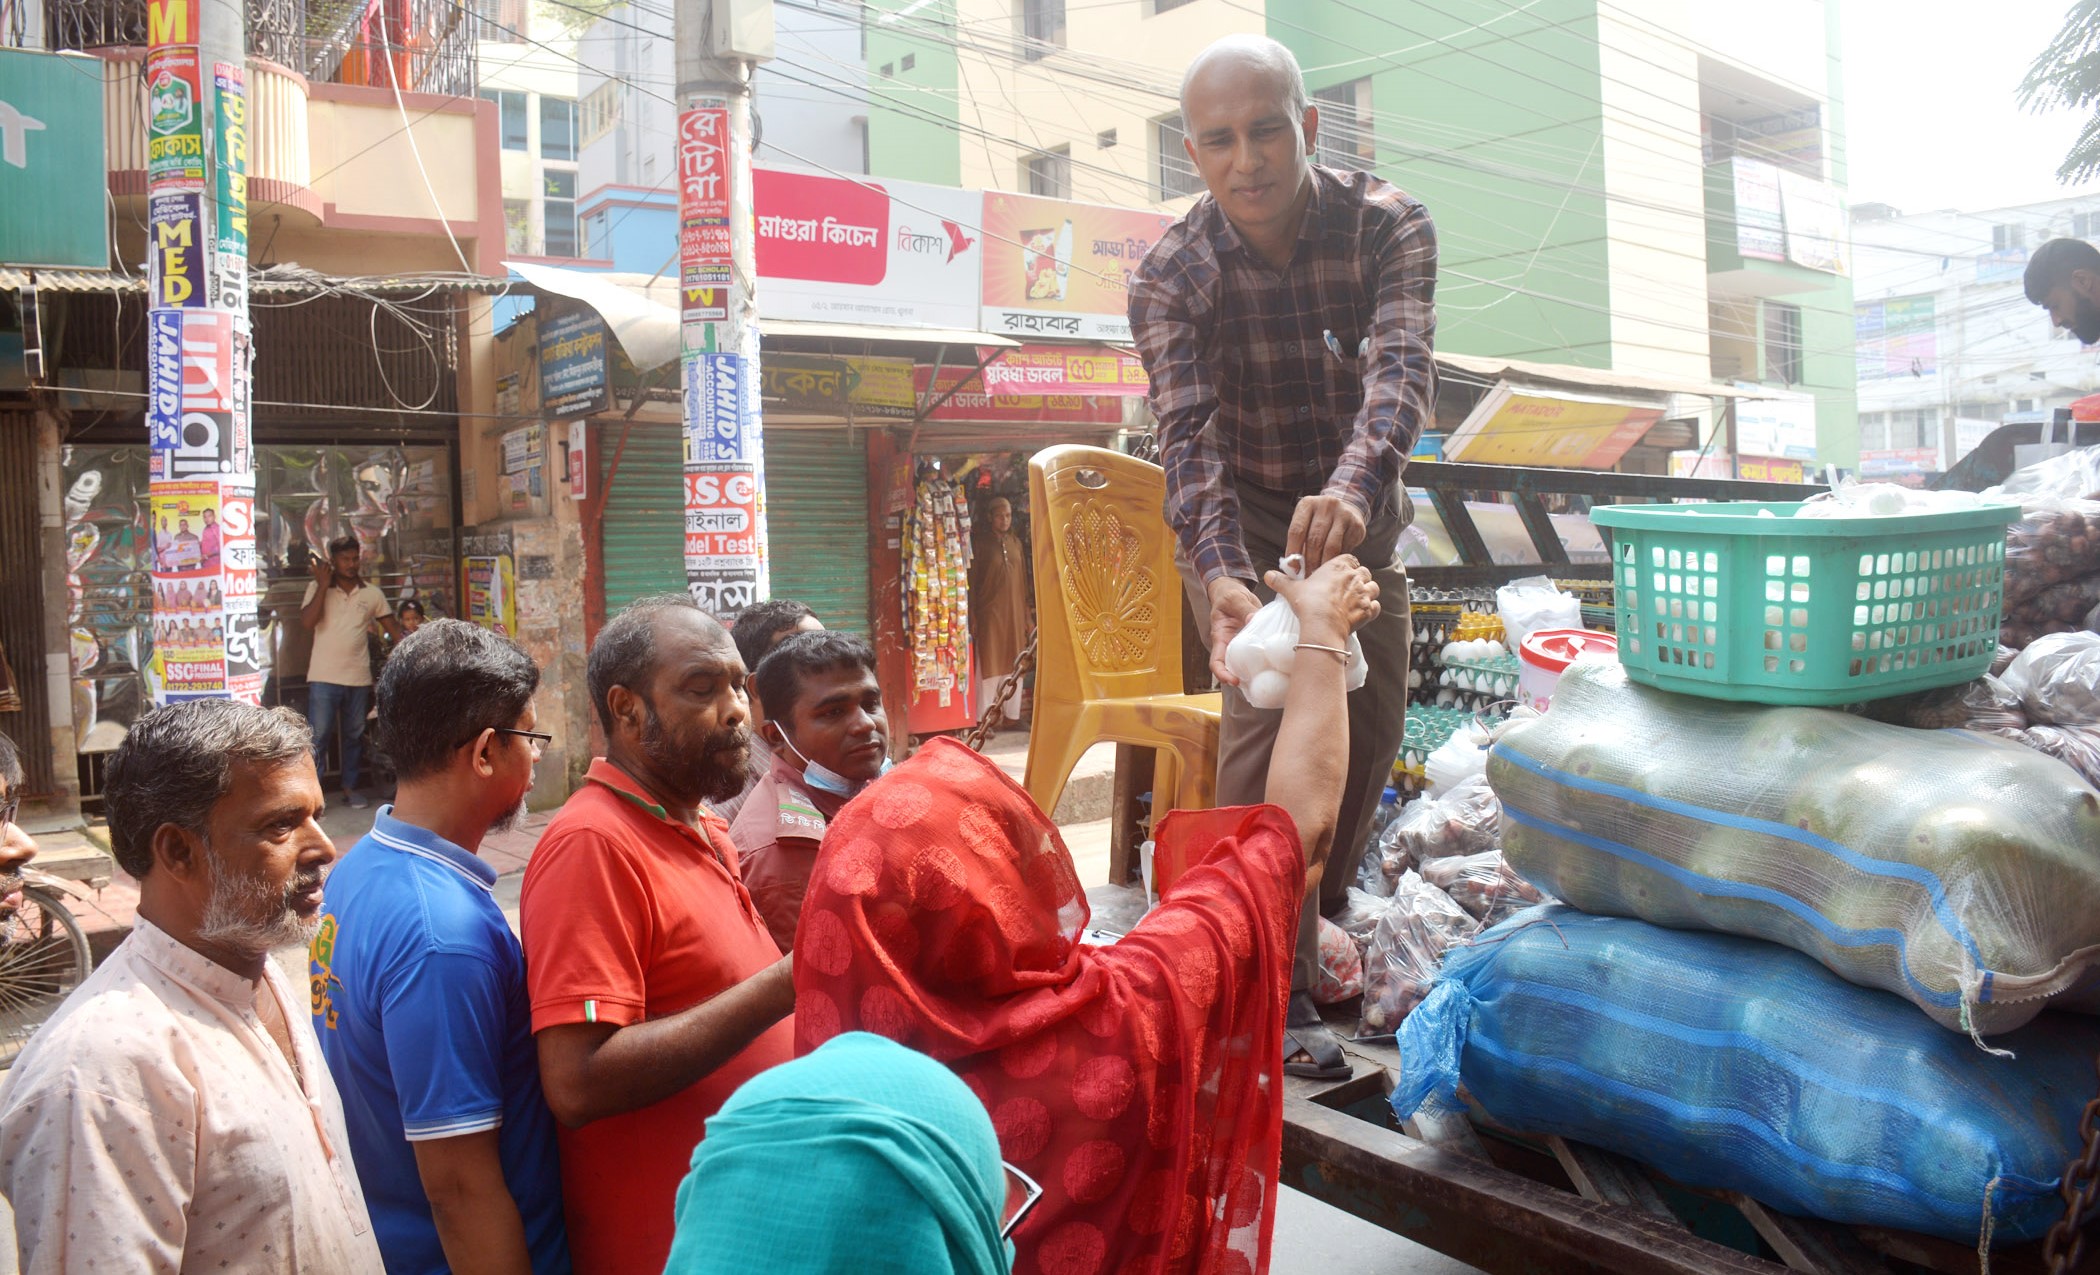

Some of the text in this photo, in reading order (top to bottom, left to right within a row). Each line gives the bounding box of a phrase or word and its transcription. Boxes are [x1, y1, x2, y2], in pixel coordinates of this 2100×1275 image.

[758, 216, 878, 248] মাগুরা কিচেন
[897, 225, 943, 255] বিকাশ
[1002, 312, 1082, 334] রাহাবার
[158, 315, 179, 445] JAHID'S
[986, 363, 1063, 384] সুবিধা ডাবল
[706, 365, 715, 439] ACCOUNTING
[716, 356, 738, 460] JAHID'S
[714, 534, 755, 554] Test
[166, 662, 222, 681] SSC FINAL
